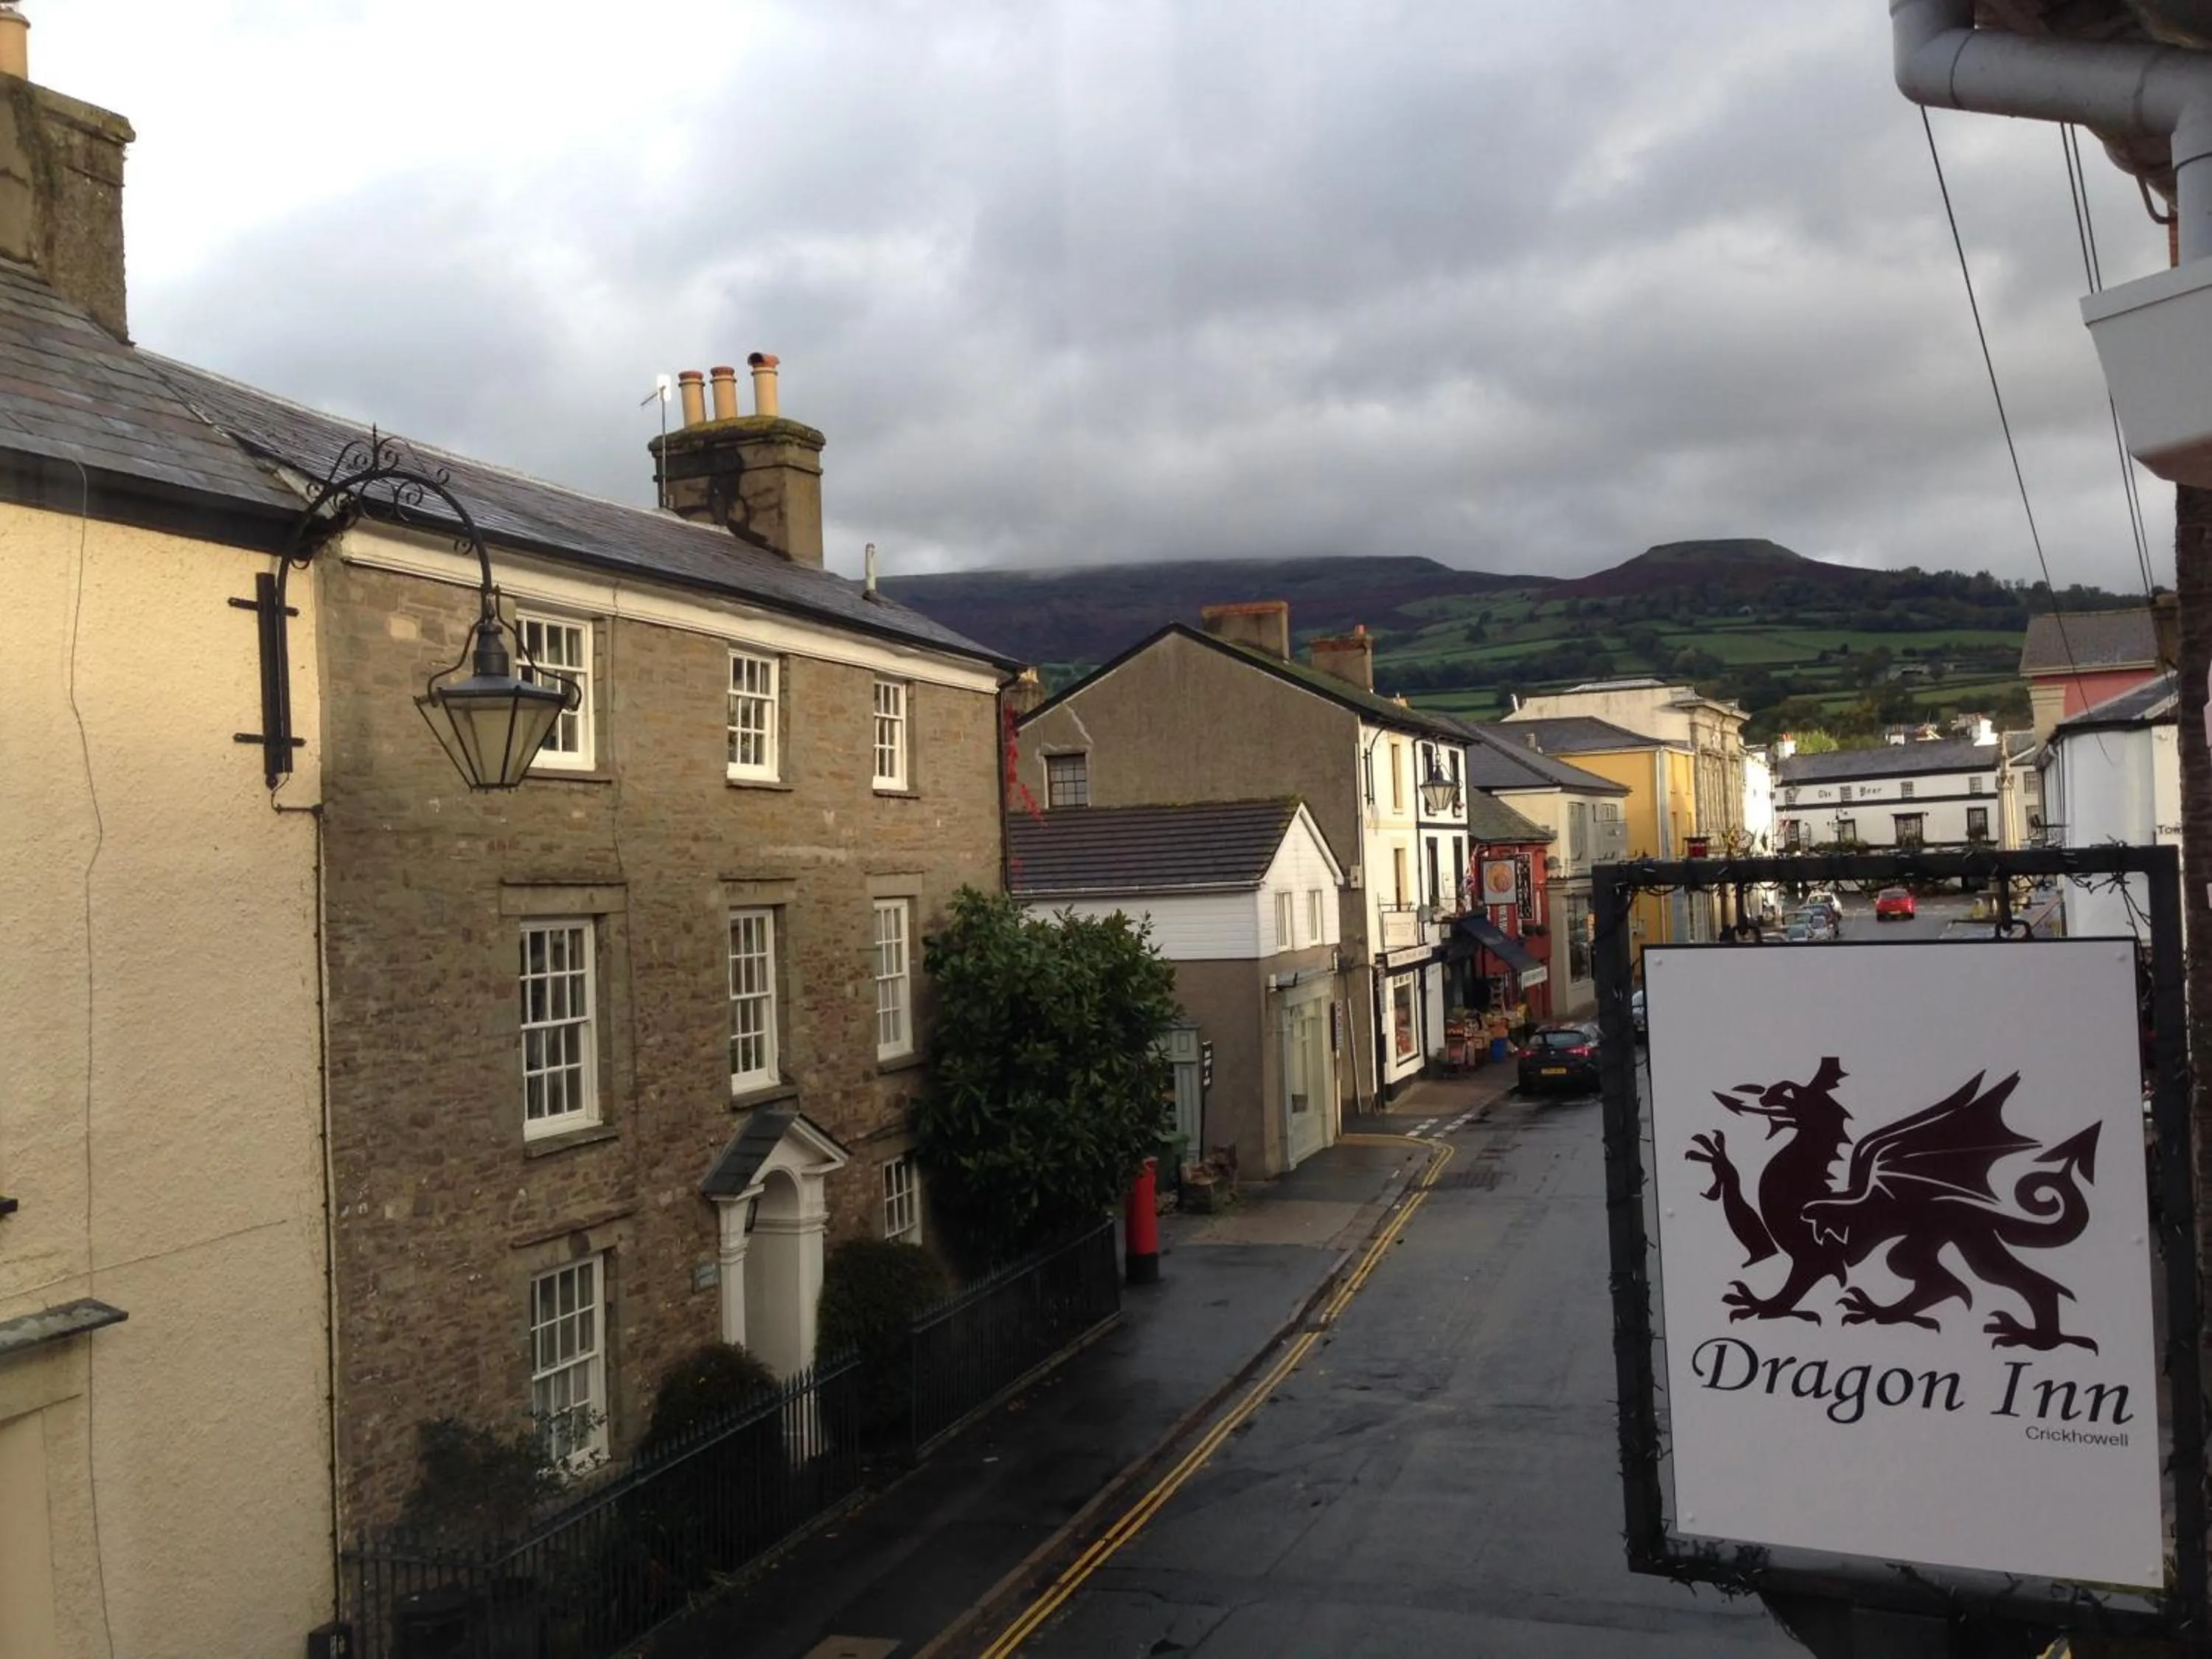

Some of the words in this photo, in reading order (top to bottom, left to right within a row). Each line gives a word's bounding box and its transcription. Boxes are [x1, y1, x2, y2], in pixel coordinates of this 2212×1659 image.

[1692, 1337, 1964, 1424] Dragon
[1990, 1362, 2134, 1425] Inn
[2025, 1425, 2129, 1447] Crickhowell
